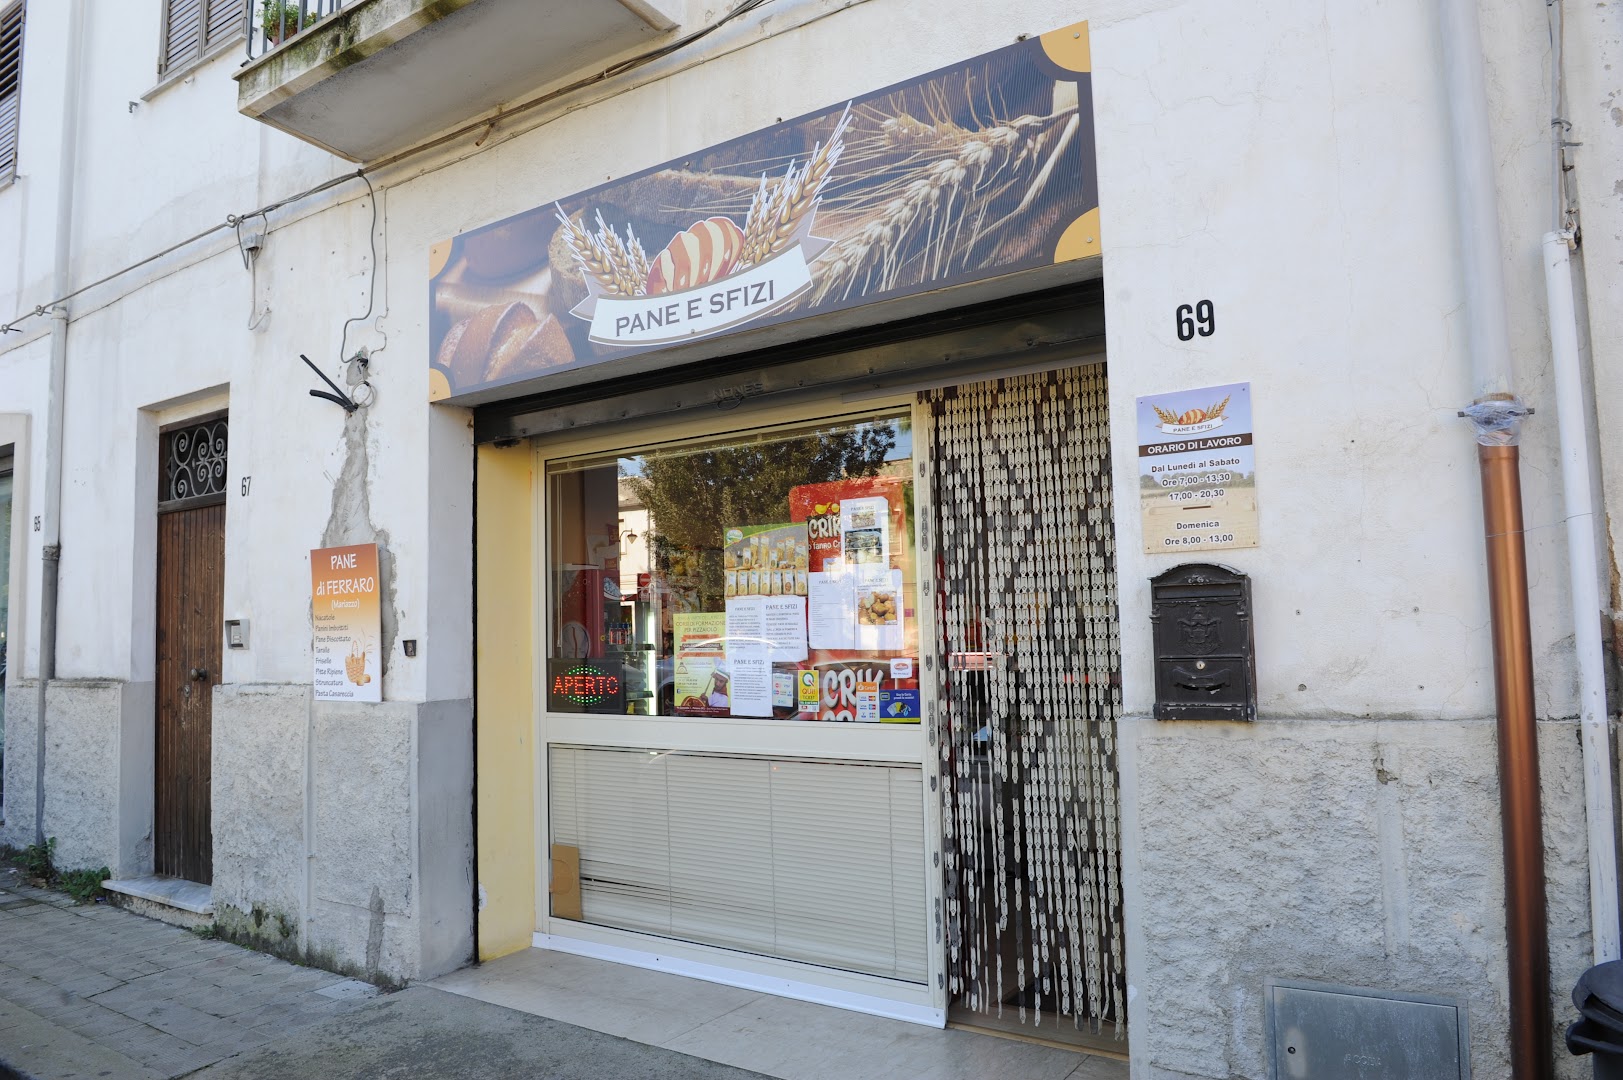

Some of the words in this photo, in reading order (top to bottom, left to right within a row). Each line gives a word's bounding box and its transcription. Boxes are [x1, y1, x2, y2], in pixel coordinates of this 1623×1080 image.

[615, 303, 680, 337] PANE
[687, 297, 703, 321] E
[709, 279, 774, 314] SFIZI
[1176, 299, 1216, 341] 69
[1173, 426, 1191, 434] PANE
[1147, 442, 1186, 454] ORARIO
[1187, 441, 1198, 451] DI
[1200, 436, 1242, 448] LAVORO
[1151, 465, 1165, 473] Dal
[1198, 460, 1207, 468] al
[1209, 457, 1240, 467] Sabato
[241, 476, 253, 497] 67
[1162, 479, 1177, 487] Ore
[1180, 476, 1198, 486] 7,00
[1206, 473, 1230, 483] 13,30
[1169, 491, 1192, 501] 17,00
[1200, 488, 1224, 499] 20,30
[33, 515, 41, 532] 65
[1176, 520, 1220, 530] Domenica
[1164, 538, 1180, 546] Ore
[1182, 536, 1201, 546] 8,00
[1209, 533, 1234, 544] 13,00
[330, 553, 357, 570] PANE
[316, 580, 325, 595] di
[327, 576, 374, 595] FERRARO
[327, 635, 351, 643] Biscottato
[327, 668, 343, 677] Ripiene
[553, 676, 619, 695] APERTO
